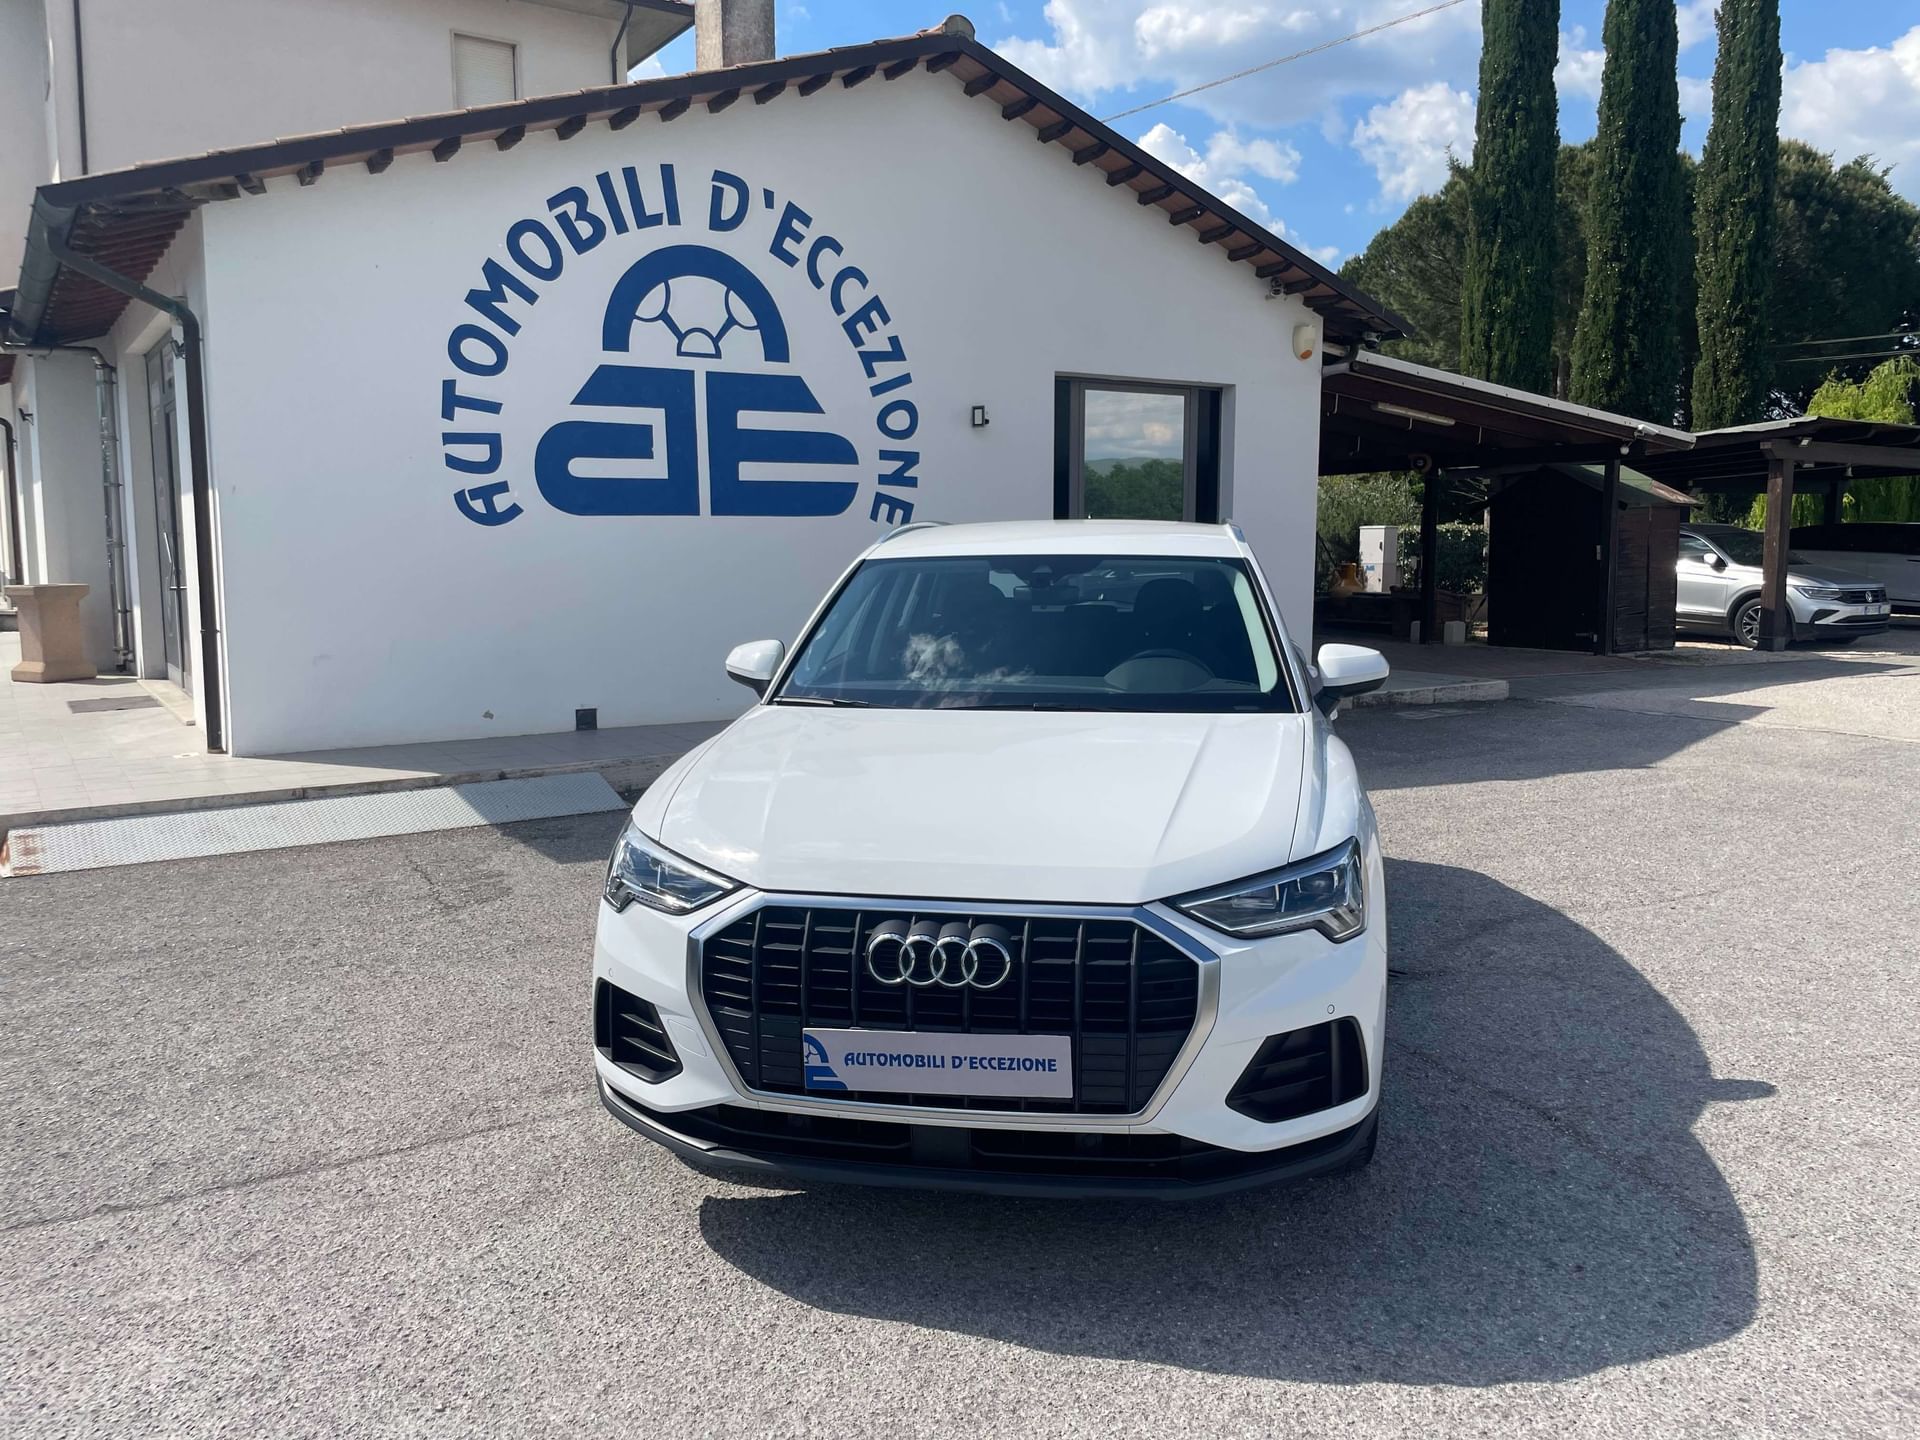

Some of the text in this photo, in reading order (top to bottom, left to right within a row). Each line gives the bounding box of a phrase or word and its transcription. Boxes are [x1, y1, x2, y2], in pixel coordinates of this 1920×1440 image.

[441, 163, 920, 527] AUTOMOBILI D'ECCEZIONE
[844, 1052, 1057, 1073] AUTOMOBILI D'ECCEZIONE
